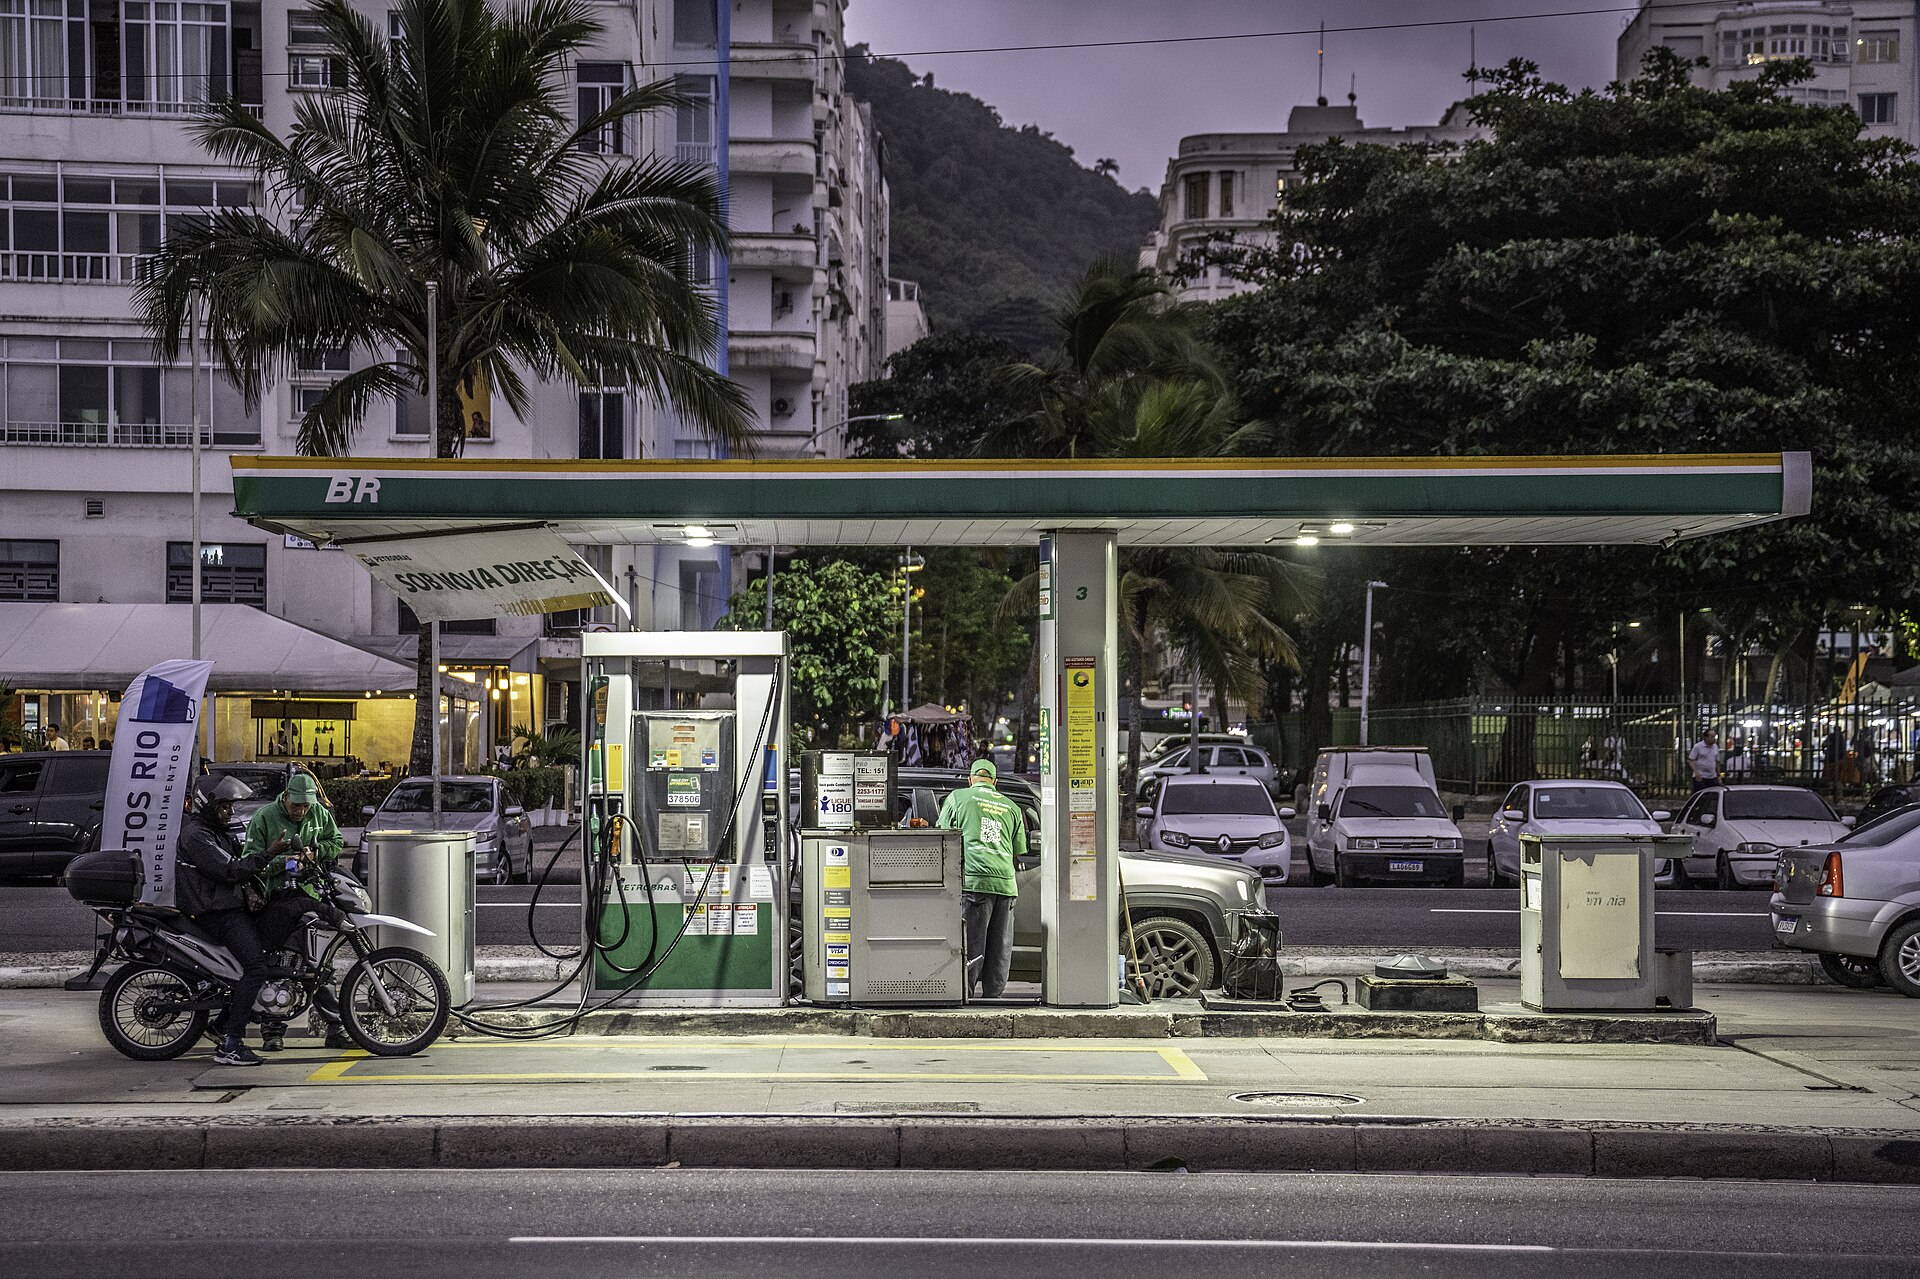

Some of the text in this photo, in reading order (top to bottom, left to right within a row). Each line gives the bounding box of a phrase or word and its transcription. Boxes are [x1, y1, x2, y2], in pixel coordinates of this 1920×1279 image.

[325, 475, 382, 503] BR
[395, 555, 594, 593] SOB NOVA DIREÇÃO
[1075, 586, 1088, 601] 3
[131, 730, 161, 780] RIO
[668, 795, 700, 803] 378506
[831, 803, 852, 813] 180
[153, 744, 181, 892] EMPREENDIMENTOS
[618, 883, 678, 891] ETROBRAS
